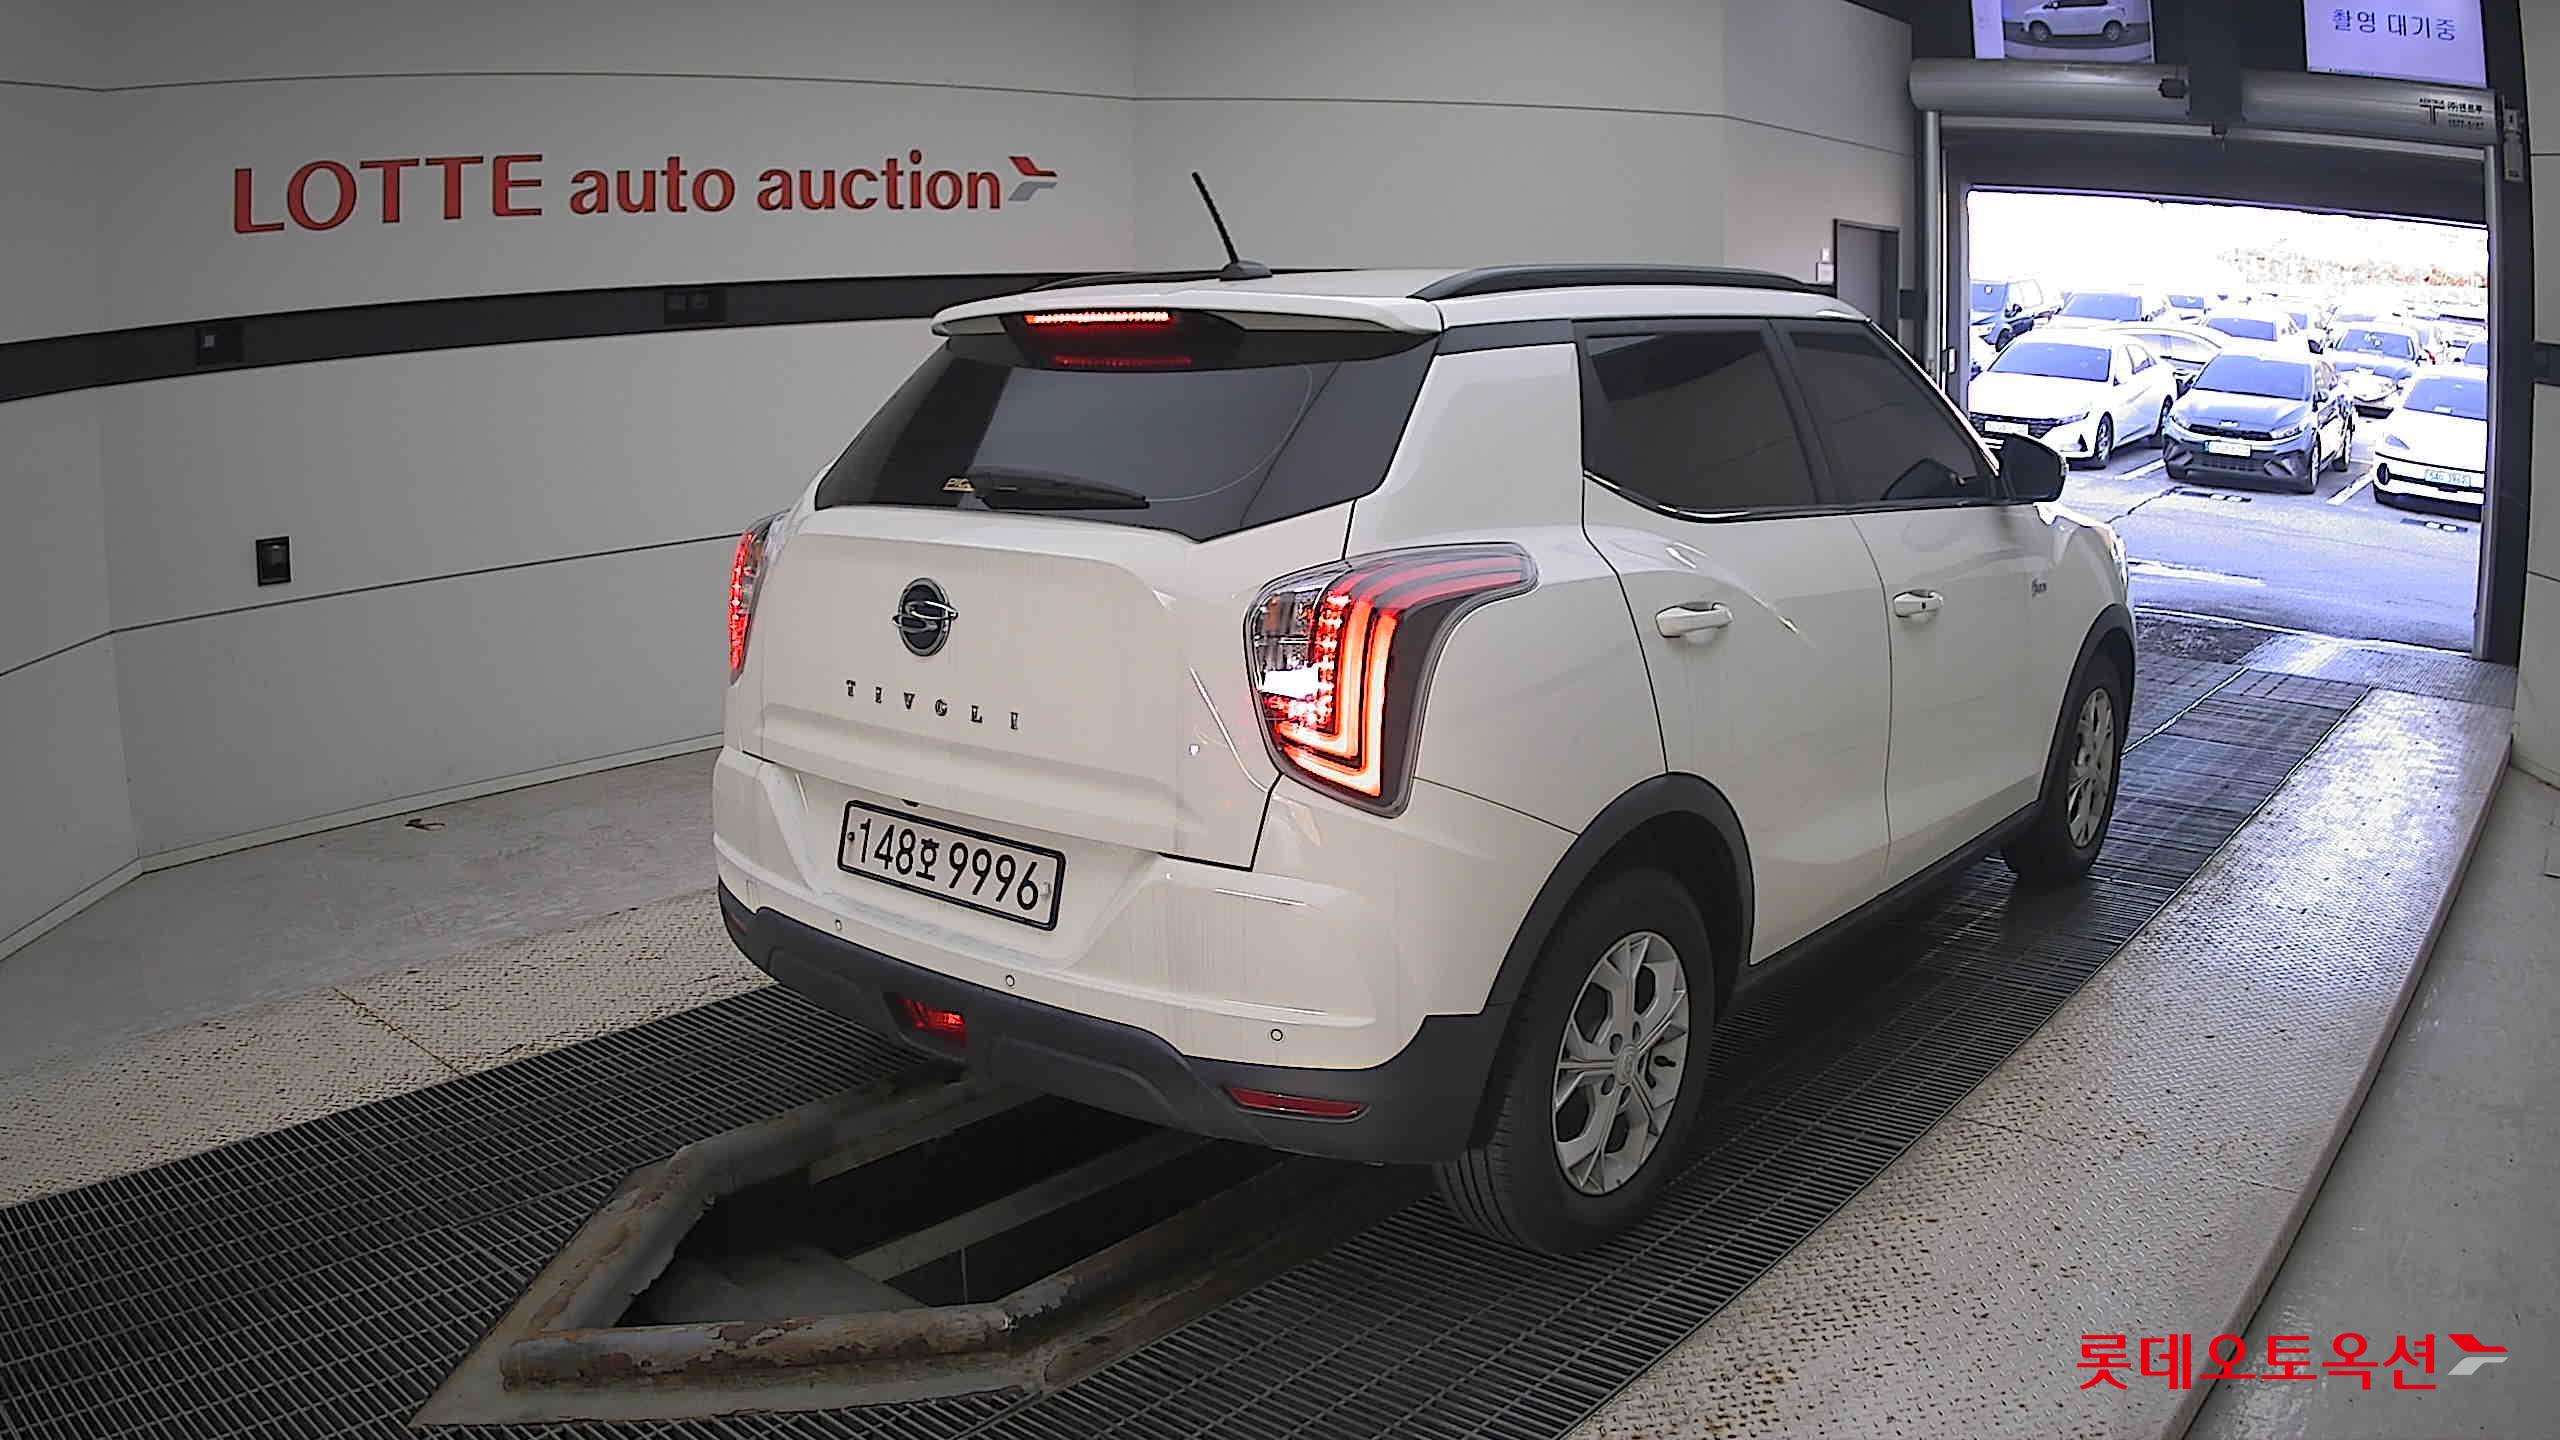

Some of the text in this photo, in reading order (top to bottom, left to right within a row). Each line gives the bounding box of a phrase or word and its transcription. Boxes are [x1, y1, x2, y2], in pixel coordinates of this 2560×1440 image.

[2332, 9, 2456, 41] 촬영 대기중
[234, 150, 1001, 234] LOTTE auto auction
[846, 679, 1020, 731] TIVOLI
[859, 817, 1039, 911] 148호9996
